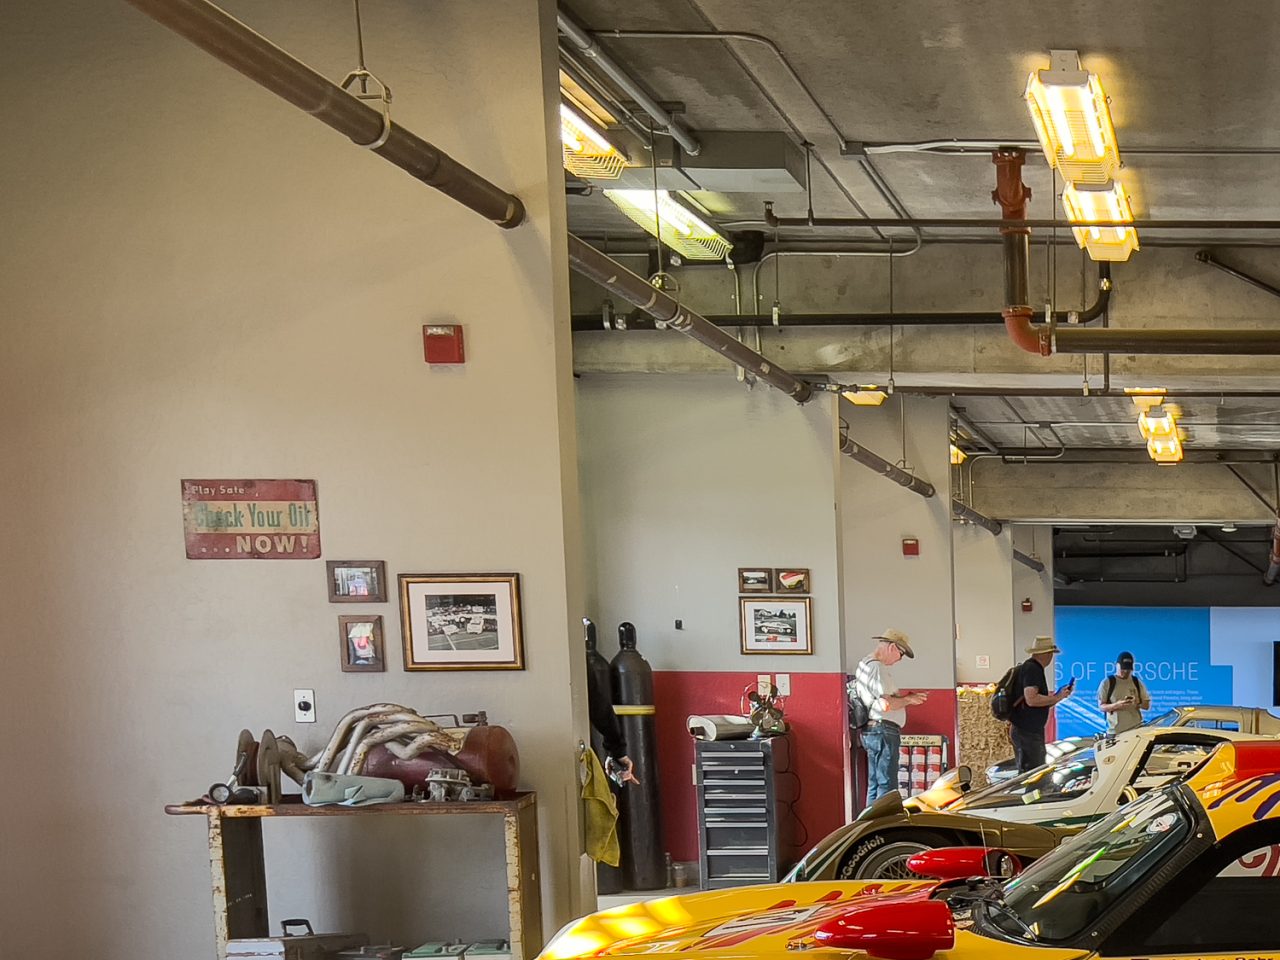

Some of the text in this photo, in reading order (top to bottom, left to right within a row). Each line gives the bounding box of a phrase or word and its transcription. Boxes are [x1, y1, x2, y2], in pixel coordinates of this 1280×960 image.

[247, 503, 282, 527] Your
[1071, 661, 1096, 681] OF
[1104, 661, 1199, 681] PRSCHE
